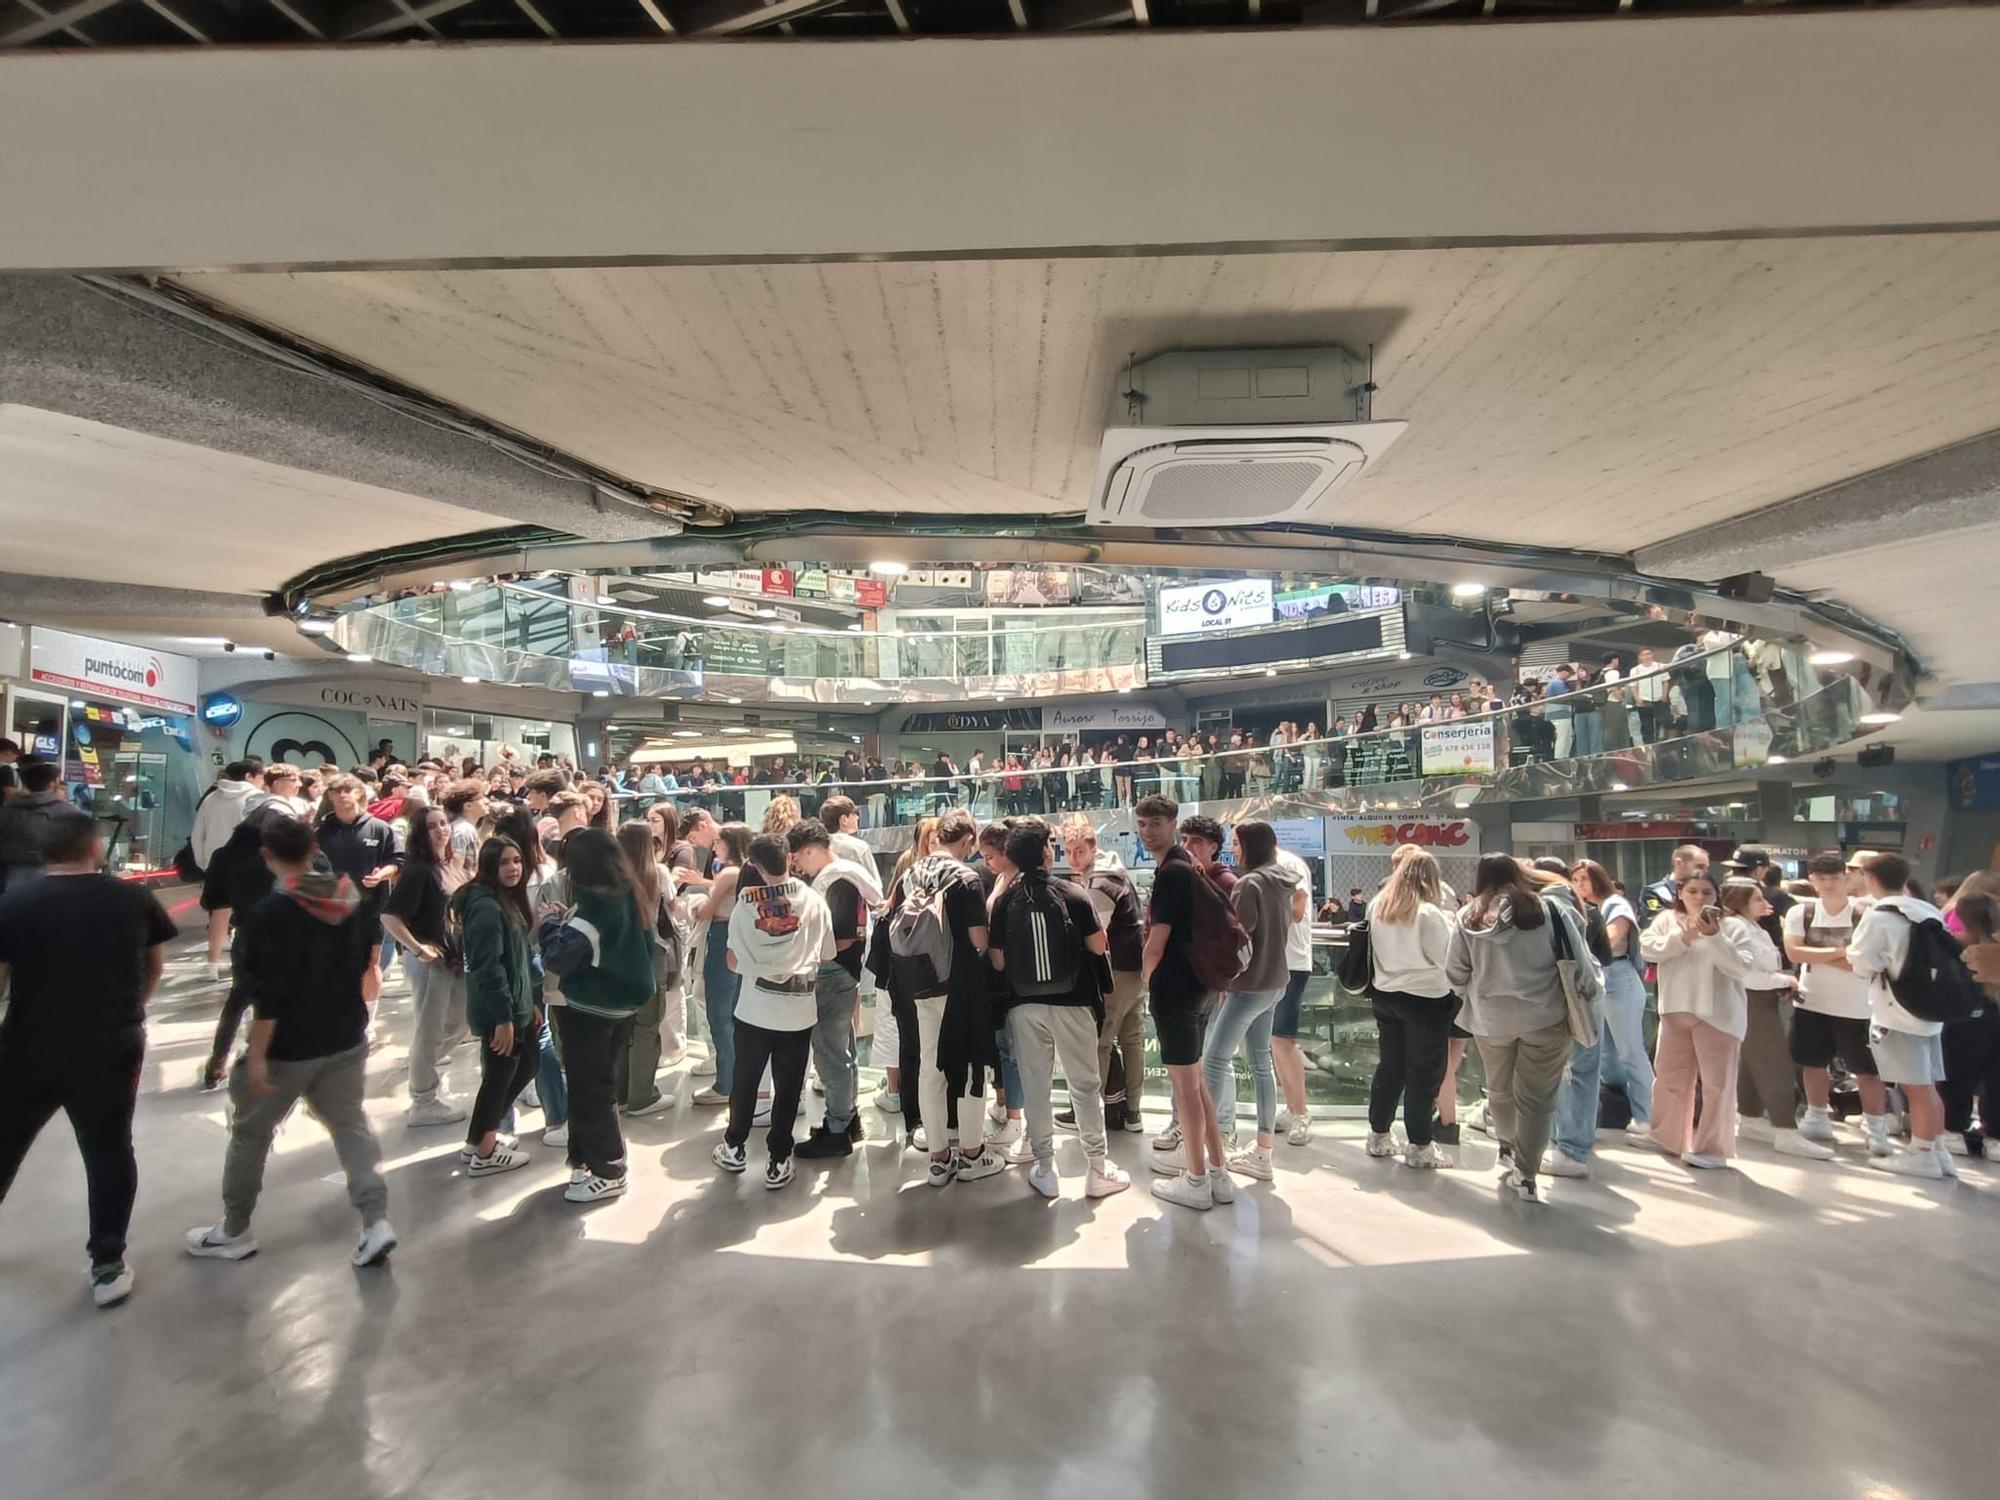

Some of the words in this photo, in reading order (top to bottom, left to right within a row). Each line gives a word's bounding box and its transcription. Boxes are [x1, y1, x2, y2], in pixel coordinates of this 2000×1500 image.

[1166, 599, 1200, 613] Kids
[1227, 591, 1265, 607] Nits
[1202, 619, 1223, 627] LOCAL
[85, 658, 144, 684] puntocom
[1053, 710, 1095, 725] Aurora
[1423, 725, 1491, 741] Conserjería
[36, 736, 56, 749] GLS
